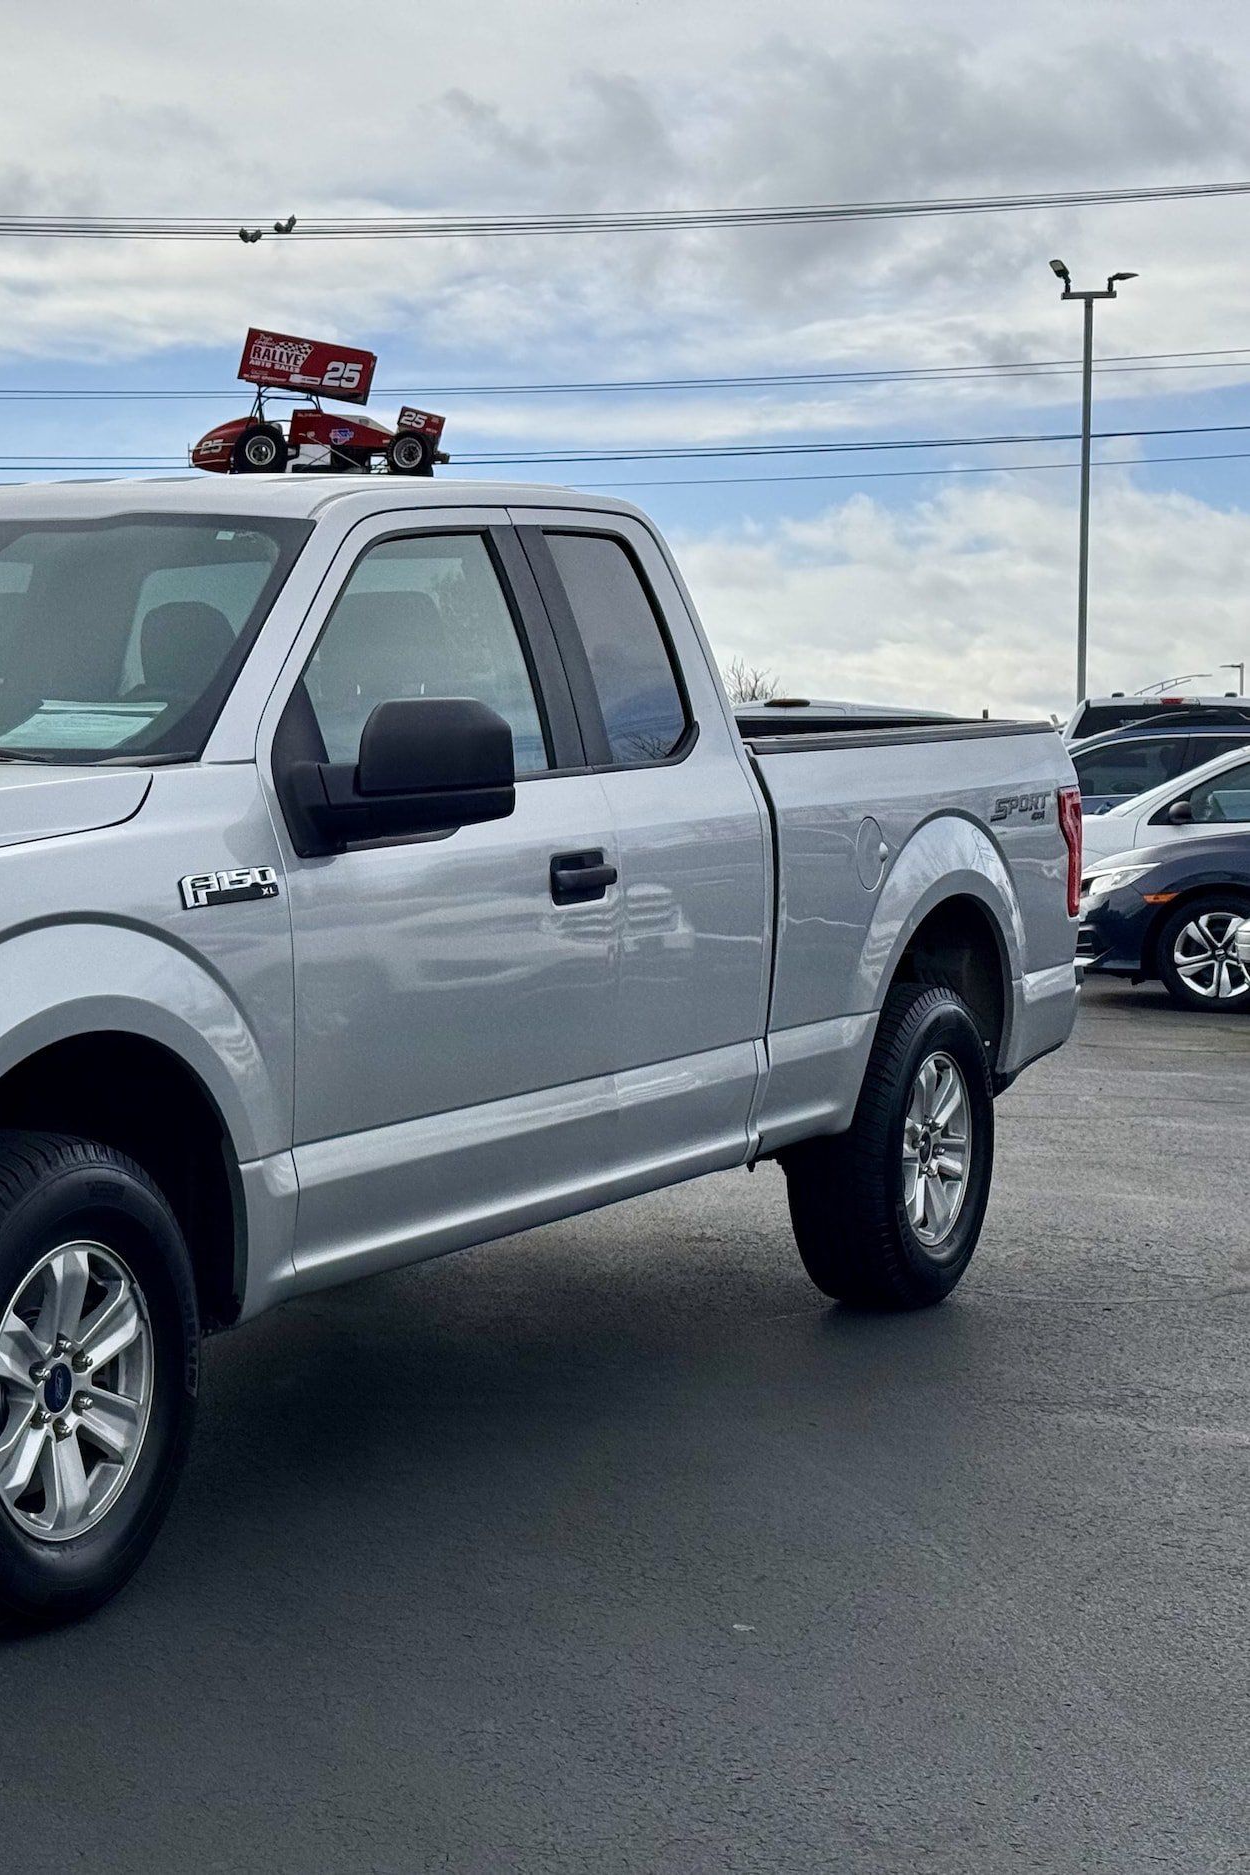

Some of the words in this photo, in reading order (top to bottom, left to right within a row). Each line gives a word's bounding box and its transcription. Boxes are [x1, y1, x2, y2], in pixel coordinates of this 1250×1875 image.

[252, 346, 303, 366] RALLYE
[249, 360, 271, 369] AUTO
[274, 363, 300, 373] SALES
[322, 361, 363, 388] 25
[400, 411, 428, 428] 25
[990, 791, 1051, 822] SPORT
[261, 886, 275, 896] XL
